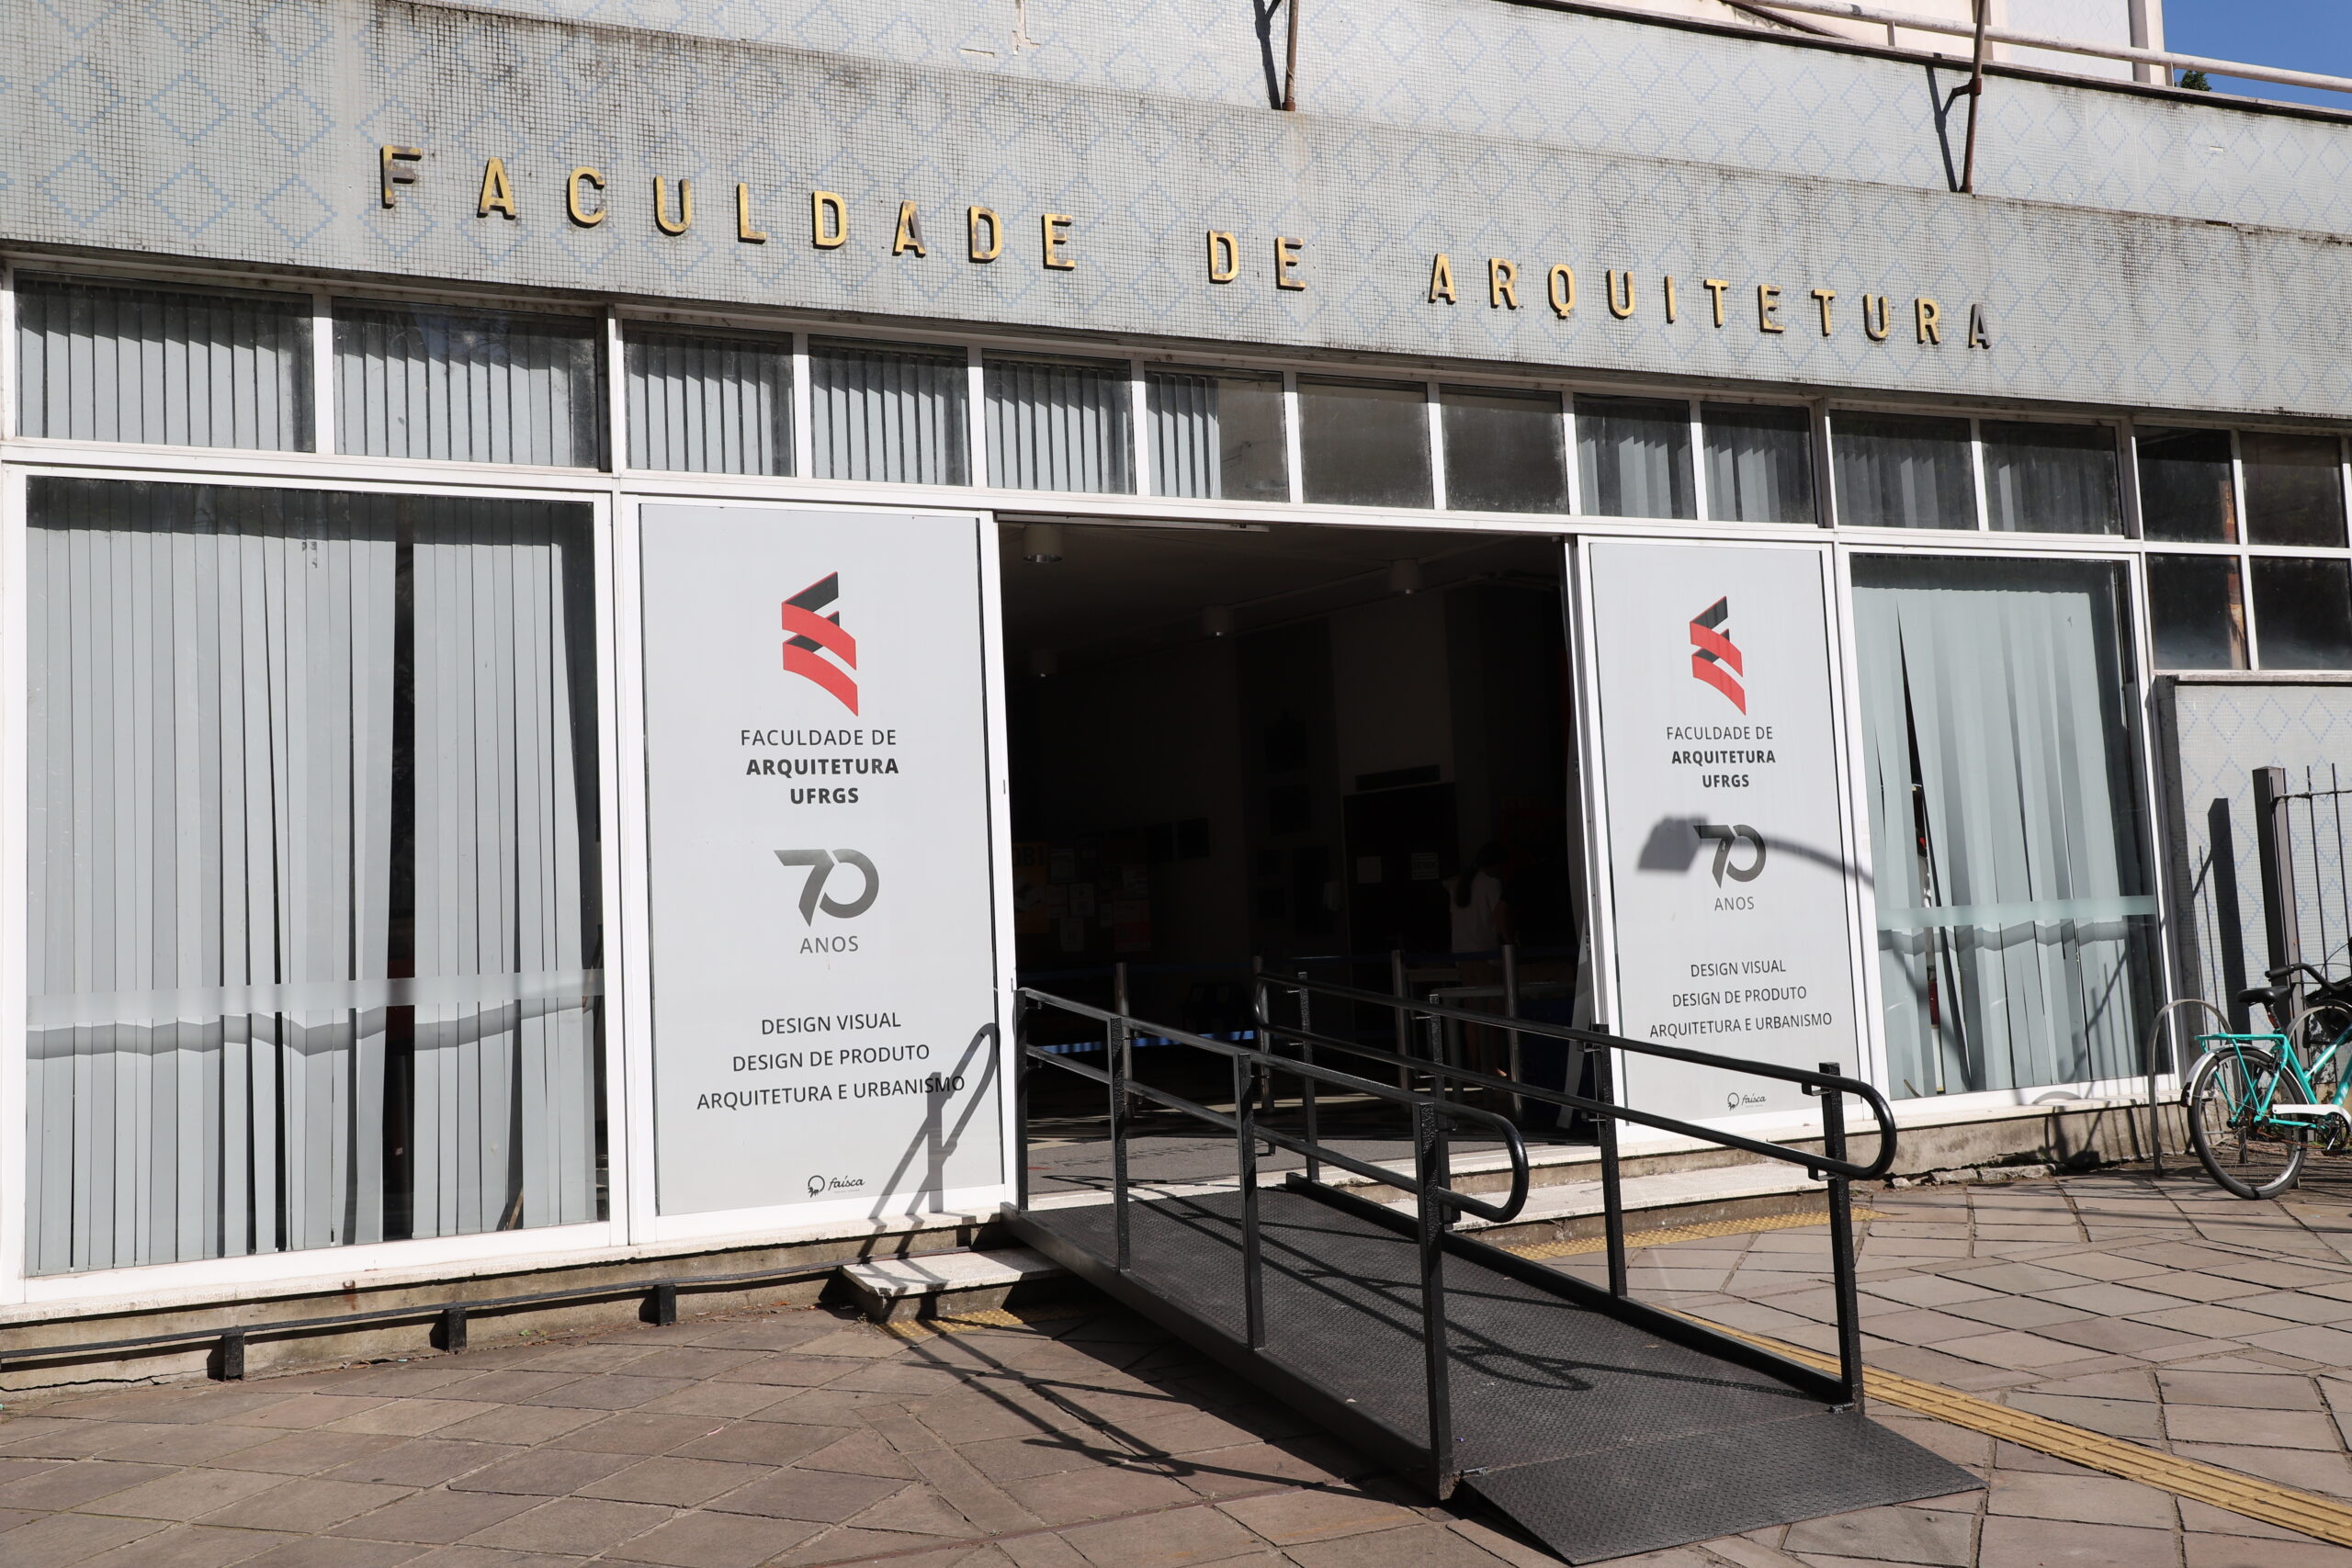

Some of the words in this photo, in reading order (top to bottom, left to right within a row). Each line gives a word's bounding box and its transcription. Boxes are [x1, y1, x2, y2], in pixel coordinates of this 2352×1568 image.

[380, 144, 1076, 270] FACULDADE
[1206, 230, 1306, 290] DE
[1428, 253, 1992, 350] ARQUITETURA
[741, 729, 864, 746] FACULDADE
[872, 729, 897, 745] DE
[1667, 727, 1750, 740] FACULDADE
[1756, 727, 1774, 740] DE
[746, 758, 899, 779] ARQUITETURA
[1671, 750, 1776, 767] ARQUITETURA
[1702, 774, 1750, 789] UFRGS
[790, 787, 859, 806] UFRGS
[1692, 824, 1767, 889] 70
[774, 848, 880, 928] 70
[1714, 897, 1755, 912] ANOS
[799, 935, 859, 954] ANOS
[1690, 963, 1738, 978] DESIGN
[1742, 960, 1787, 975] VISUAL
[1672, 992, 1721, 1008] DESIGN
[1724, 990, 1741, 1004] DE
[1745, 986, 1807, 1003] PRODUTO
[762, 1016, 831, 1035] DESIGN
[836, 1012, 901, 1030] VISUAL
[1649, 1019, 1742, 1040] ARQUITETURA
[1745, 1018, 1752, 1032] E
[1755, 1012, 1833, 1031] URBANISMO
[732, 1052, 803, 1072] DESIGN
[809, 1050, 833, 1067] DE
[839, 1043, 930, 1066] PRODUTO
[696, 1085, 832, 1111] ARQUITETURA
[838, 1084, 848, 1100] E
[854, 1076, 966, 1099] URBANISMO
[828, 1176, 865, 1191] faísca
